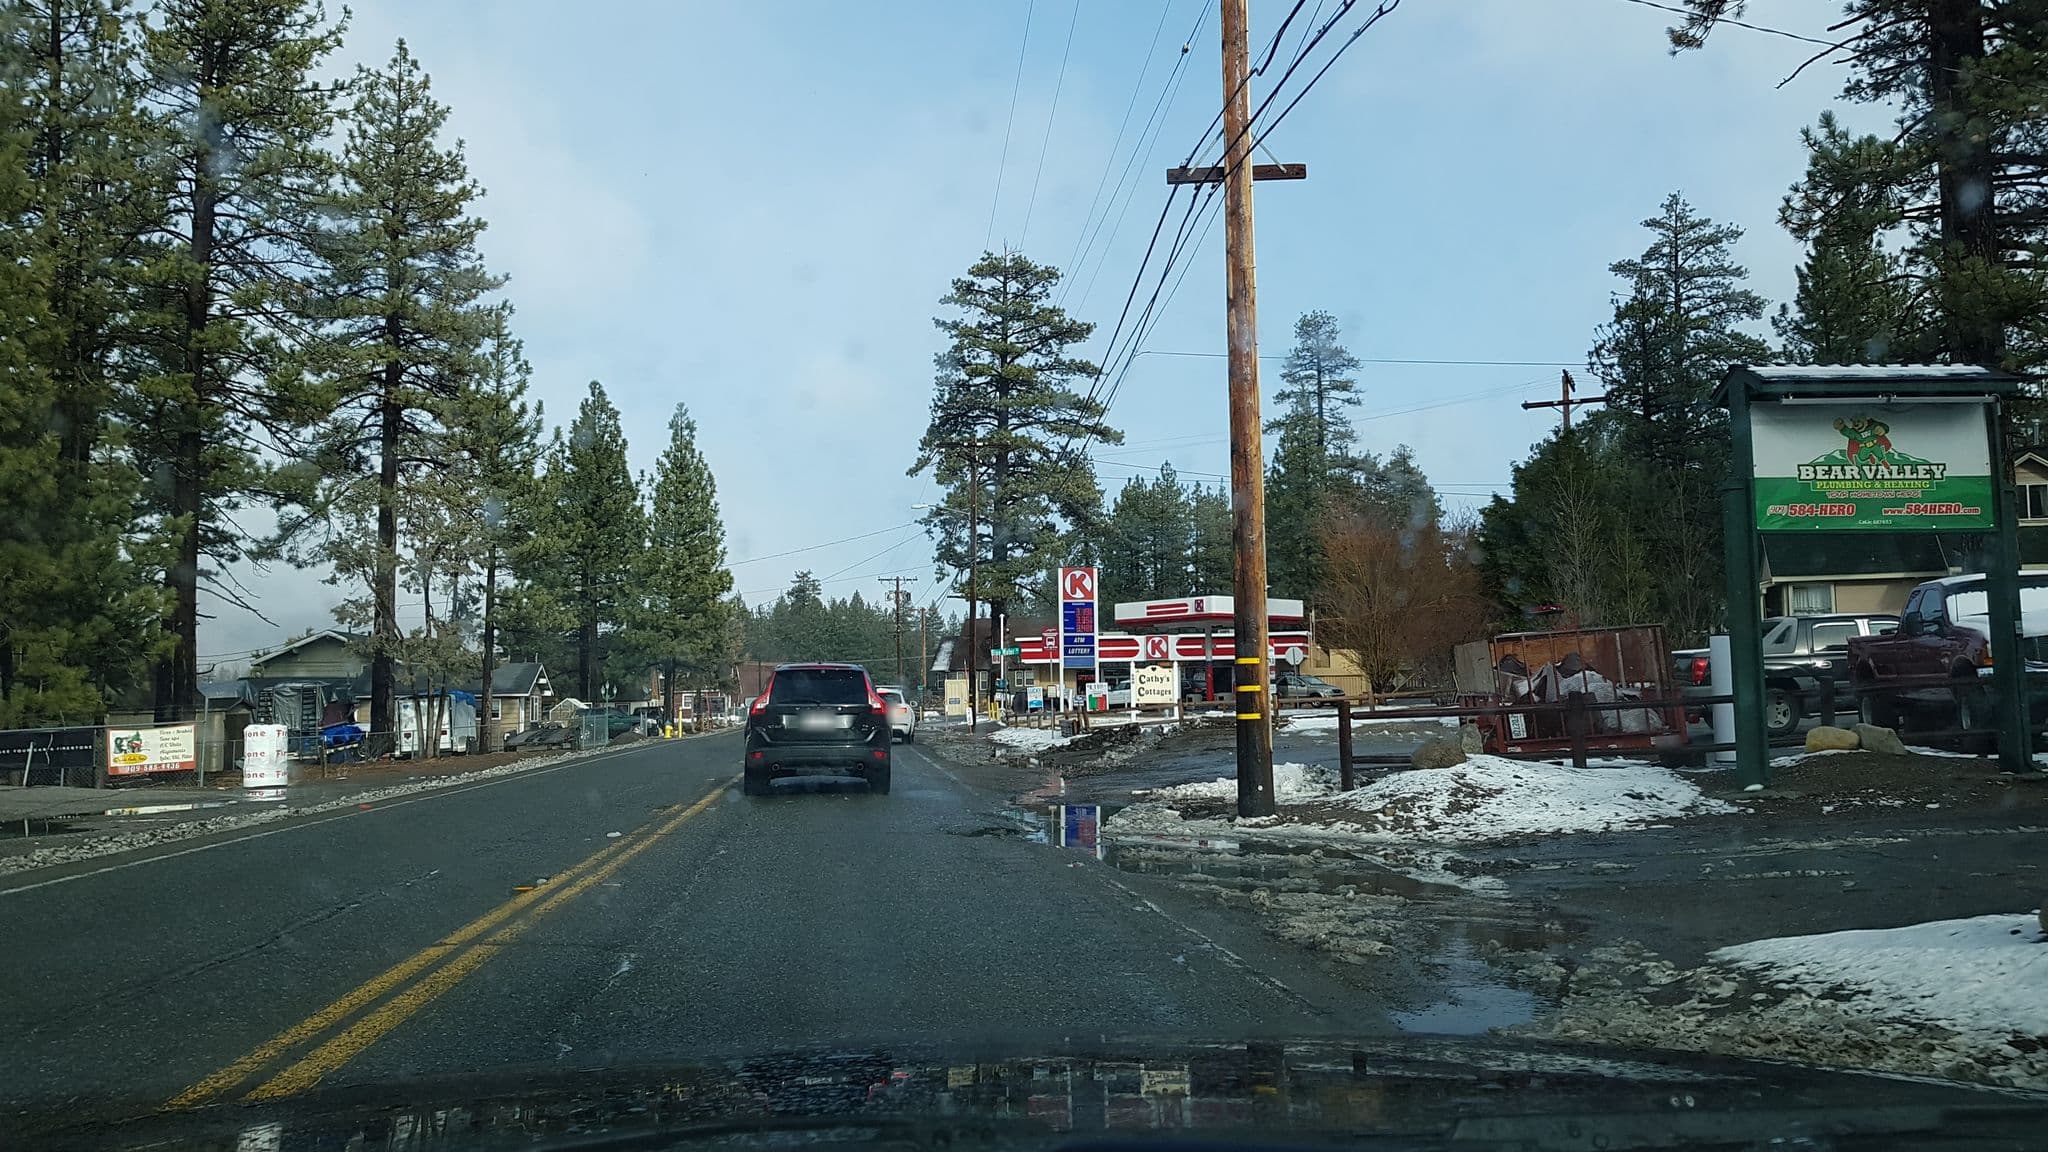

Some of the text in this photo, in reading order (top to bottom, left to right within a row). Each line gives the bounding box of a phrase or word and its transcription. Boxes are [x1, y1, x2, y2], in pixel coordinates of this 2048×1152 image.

[1799, 465, 1946, 480] BEAR VALLEY
[1816, 480, 1930, 489] PLUMBING & HEATING
[1788, 503, 1856, 516] 584-HERO
[1882, 503, 1981, 516] www.584HERO.com
[1069, 572, 1092, 598] K
[1068, 647, 1090, 655] LOTTERY
[1151, 638, 1166, 657] K
[1138, 674, 1170, 685] Cathy's
[1137, 686, 1172, 697] Cottages
